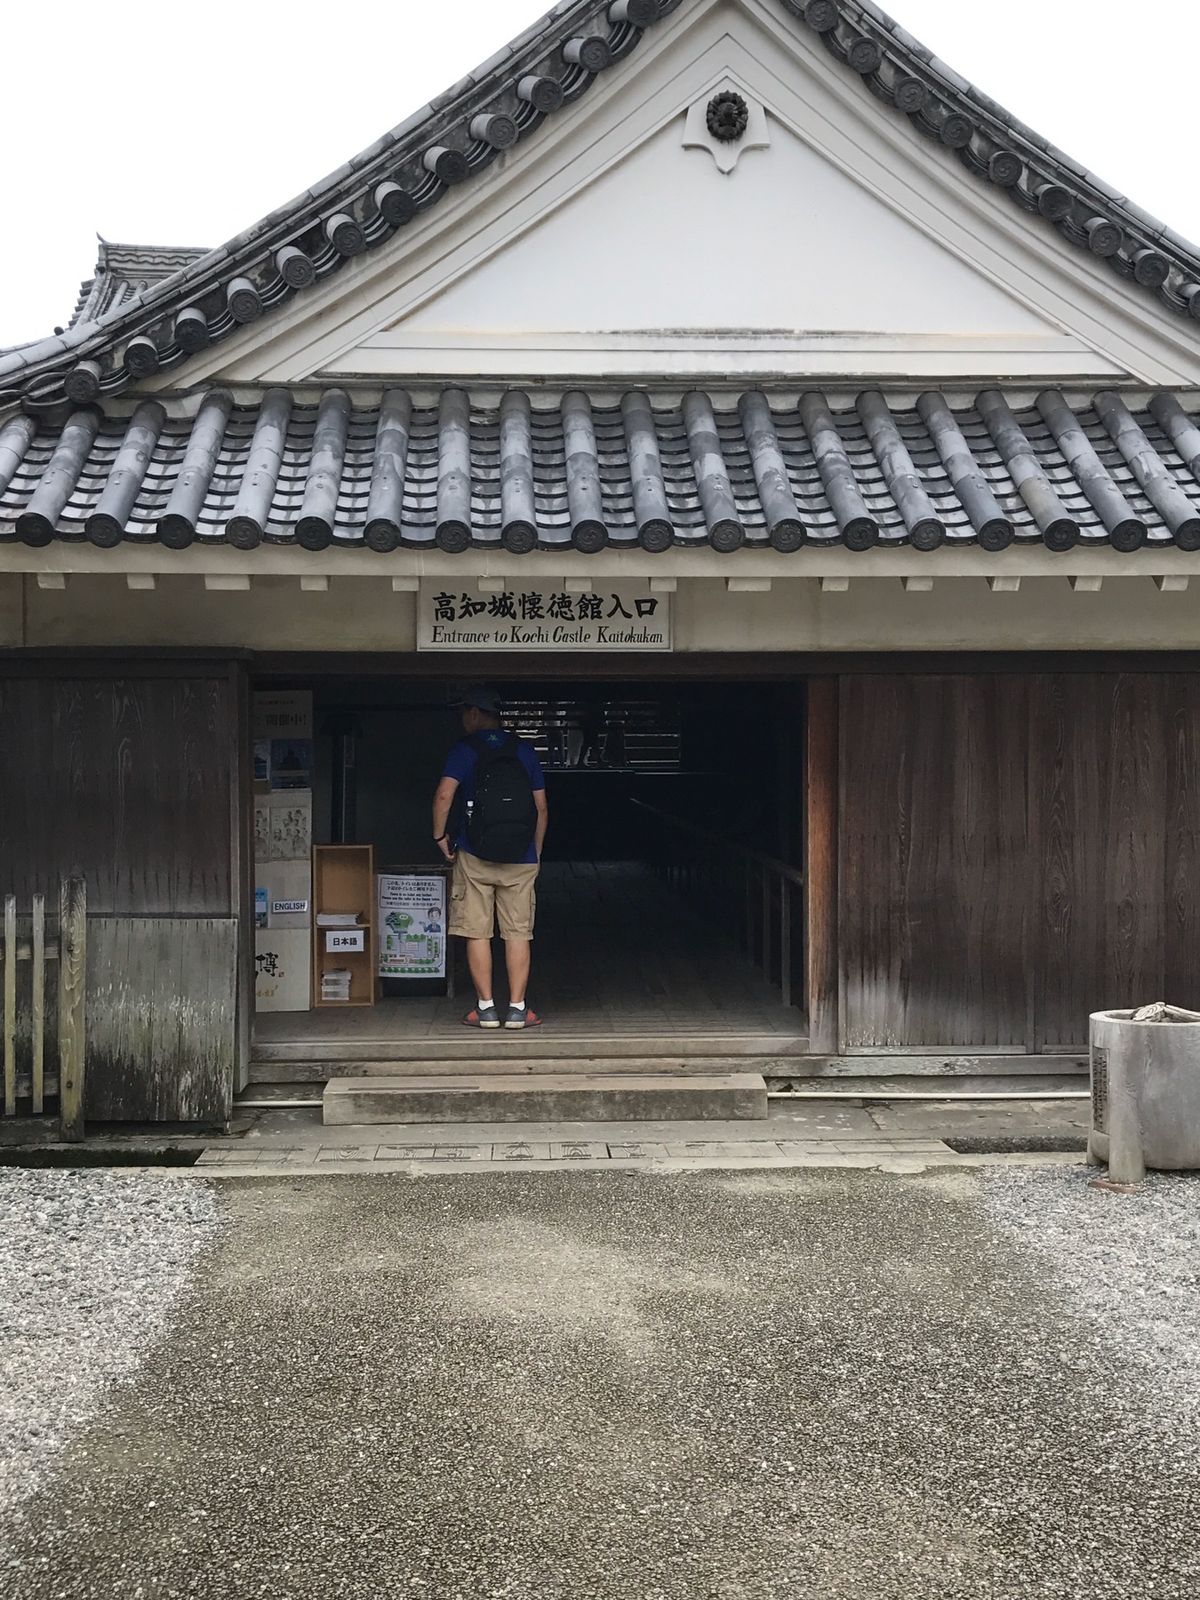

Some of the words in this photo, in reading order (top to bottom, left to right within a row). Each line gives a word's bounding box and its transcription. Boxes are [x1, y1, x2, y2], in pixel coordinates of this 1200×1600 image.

[432, 592, 658, 621] 高知城懐徳館入口
[431, 625, 490, 643] Entrance
[494, 630, 508, 643] to
[509, 625, 549, 643] Kochi
[552, 625, 591, 643] Castle
[596, 625, 664, 643] Kaitokukan
[274, 902, 306, 912] ENGLISH
[332, 937, 358, 946] 日本語
